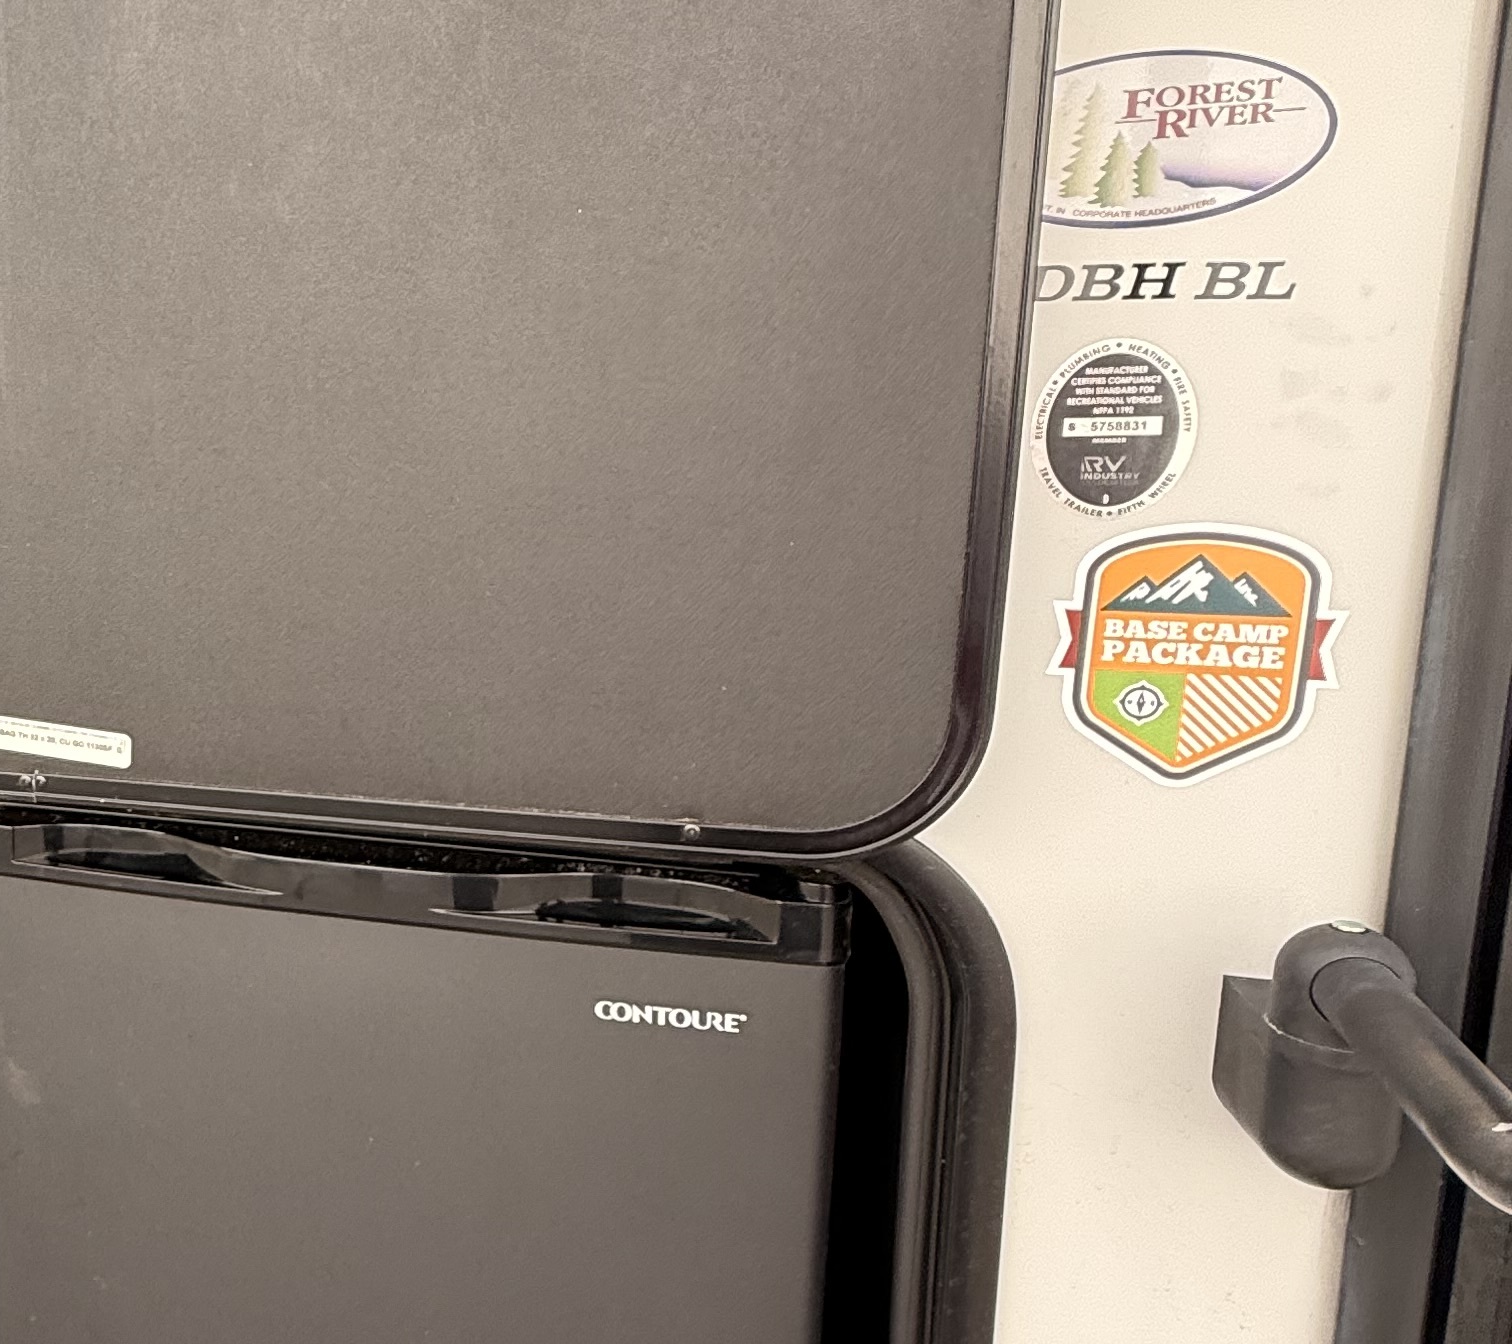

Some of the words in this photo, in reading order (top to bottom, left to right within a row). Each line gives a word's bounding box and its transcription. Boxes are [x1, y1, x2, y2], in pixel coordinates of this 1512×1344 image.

[1123, 76, 1284, 120] FOREST
[1152, 102, 1275, 140] RIVER
[1072, 209, 1132, 218] CORPORATE
[1134, 197, 1217, 217] HEADQUARTERS
[1194, 260, 1297, 301] BL
[1085, 365, 1149, 375] MANUFACTURER
[1107, 375, 1162, 385] COMPLIANCE
[1034, 387, 1057, 440] ELECTRICAL
[1128, 343, 1171, 369] HEATING
[1173, 376, 1188, 395] FIRE
[1181, 399, 1192, 432] SAFETY
[1067, 397, 1125, 406] RECREATIONAL
[1125, 395, 1163, 404] VEHICLES
[1075, 387, 1094, 395] WITH
[1095, 386, 1138, 395] STANDARD
[1139, 385, 1155, 393] FOR
[1090, 421, 1148, 432] 5758831
[1080, 472, 1141, 480] INDUSTRY
[1081, 456, 1127, 472] RV
[1039, 466, 1062, 498] TRAVEL
[1063, 497, 1103, 517] TRAILER
[1148, 472, 1177, 499] WHEEL
[1103, 618, 1189, 641] BASE
[1193, 622, 1289, 645] CAMP
[1100, 639, 1286, 670] PACKAGE
[593, 1000, 744, 1033] CONTOURE
